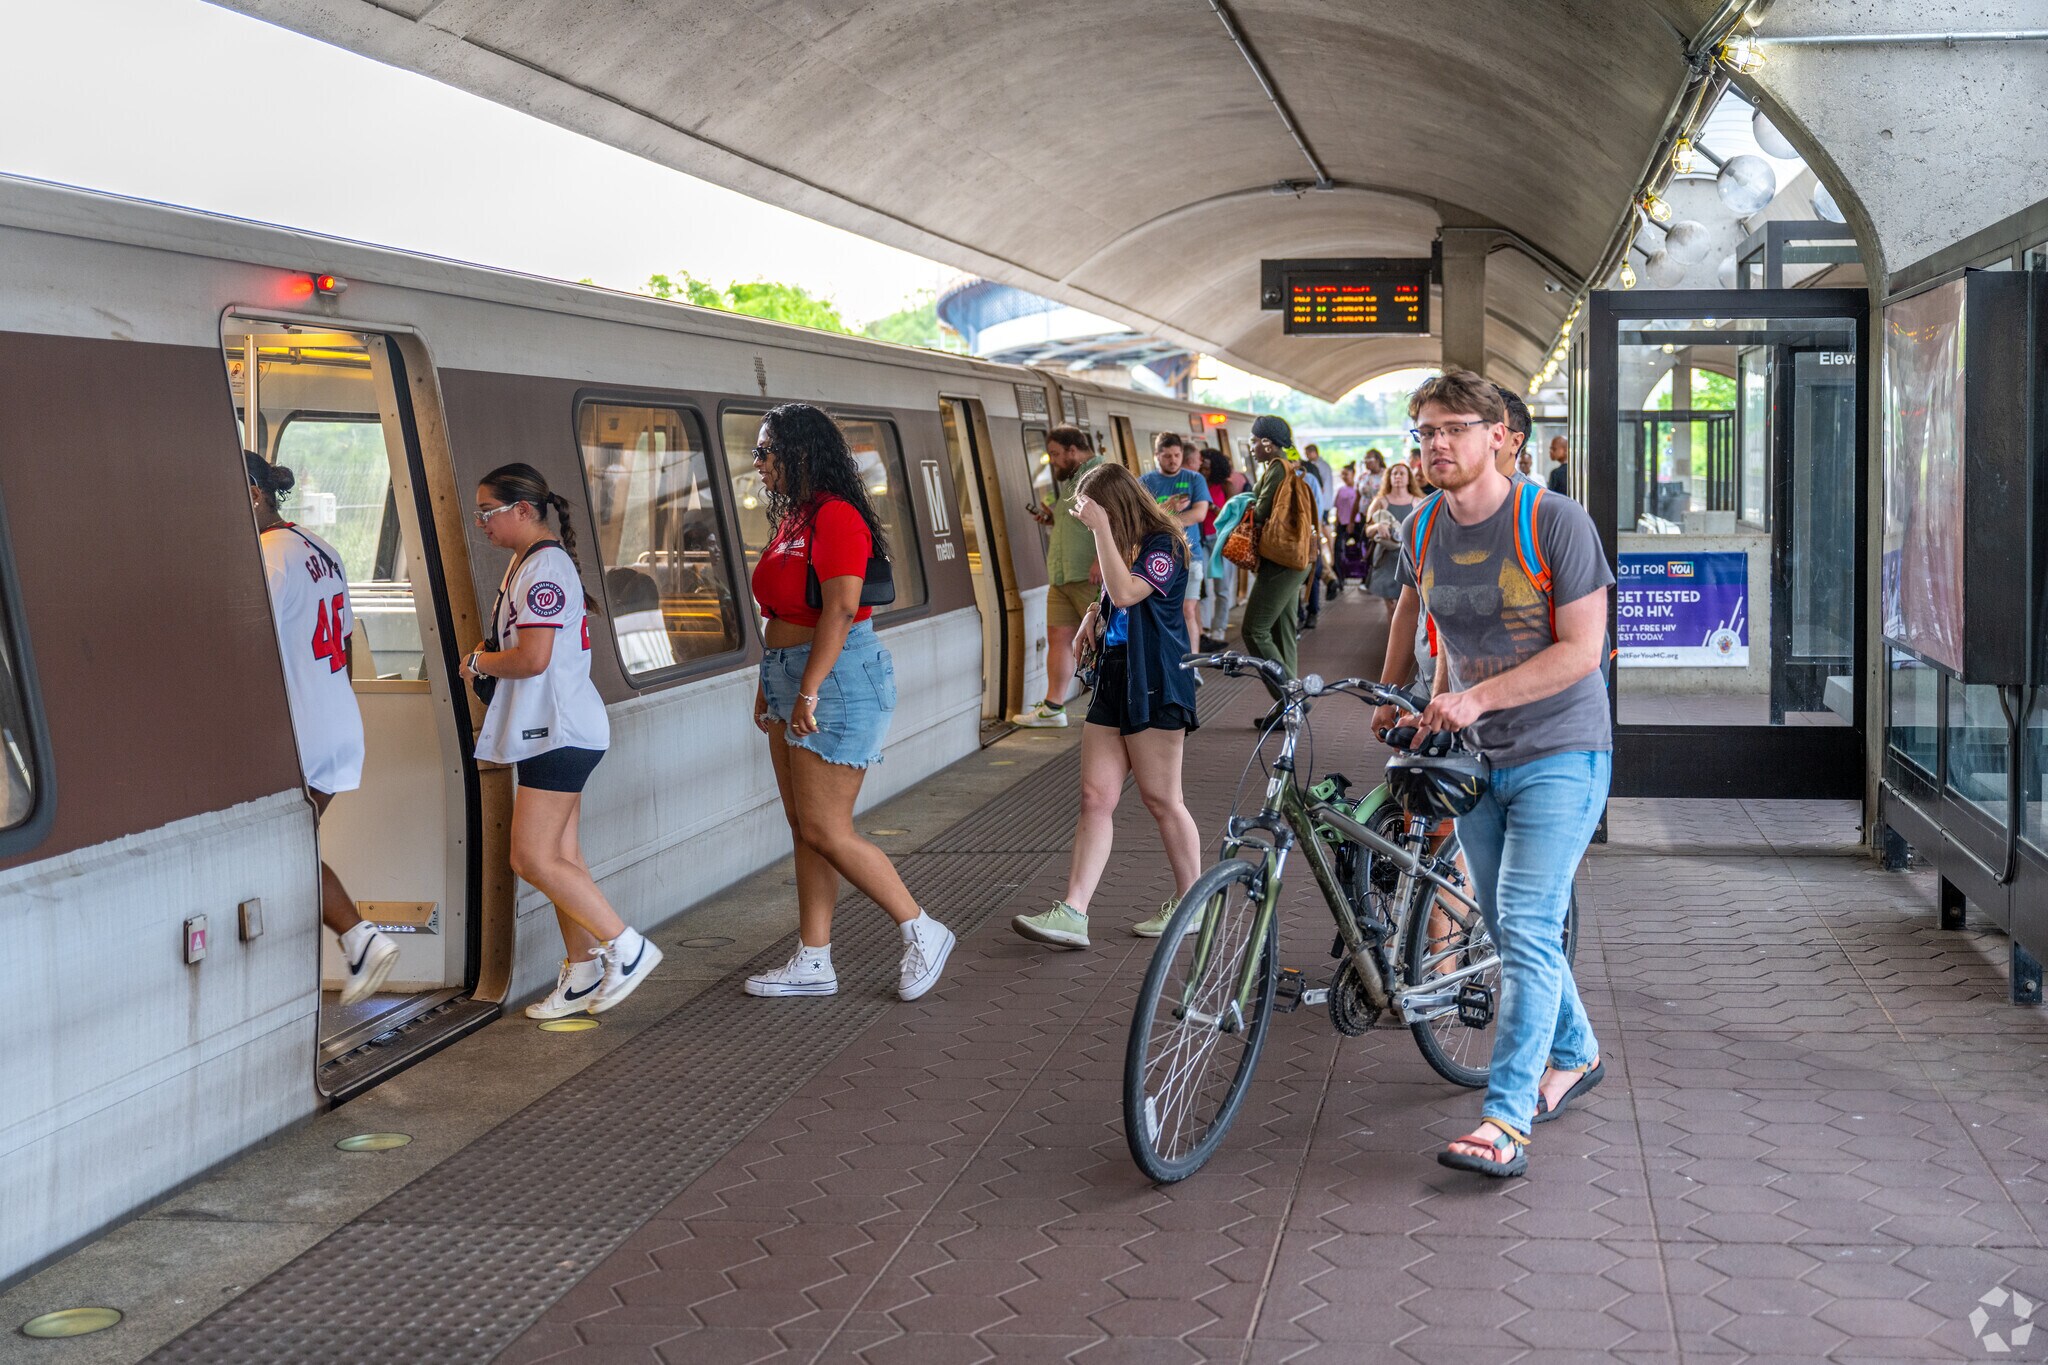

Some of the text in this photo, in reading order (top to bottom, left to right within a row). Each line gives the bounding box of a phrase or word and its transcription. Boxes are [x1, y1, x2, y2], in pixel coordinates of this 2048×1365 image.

[935, 539, 955, 562] metro
[1150, 552, 1173, 572] WASHINGTON
[1148, 564, 1168, 582] NATIONALS
[1617, 564, 1691, 575] O IT FOR YOU
[529, 582, 563, 598] WASHINGTON
[1617, 590, 1701, 603] GET TESTED
[530, 603, 562, 616] NATIONALS
[1647, 605, 1674, 617] HIV.
[1632, 624, 1638, 632] A
[1639, 624, 1660, 632] FREE
[1661, 624, 1677, 632] HIV
[1635, 633, 1664, 641] TODAY.
[1618, 650, 1679, 660] oItForYouMC.org
